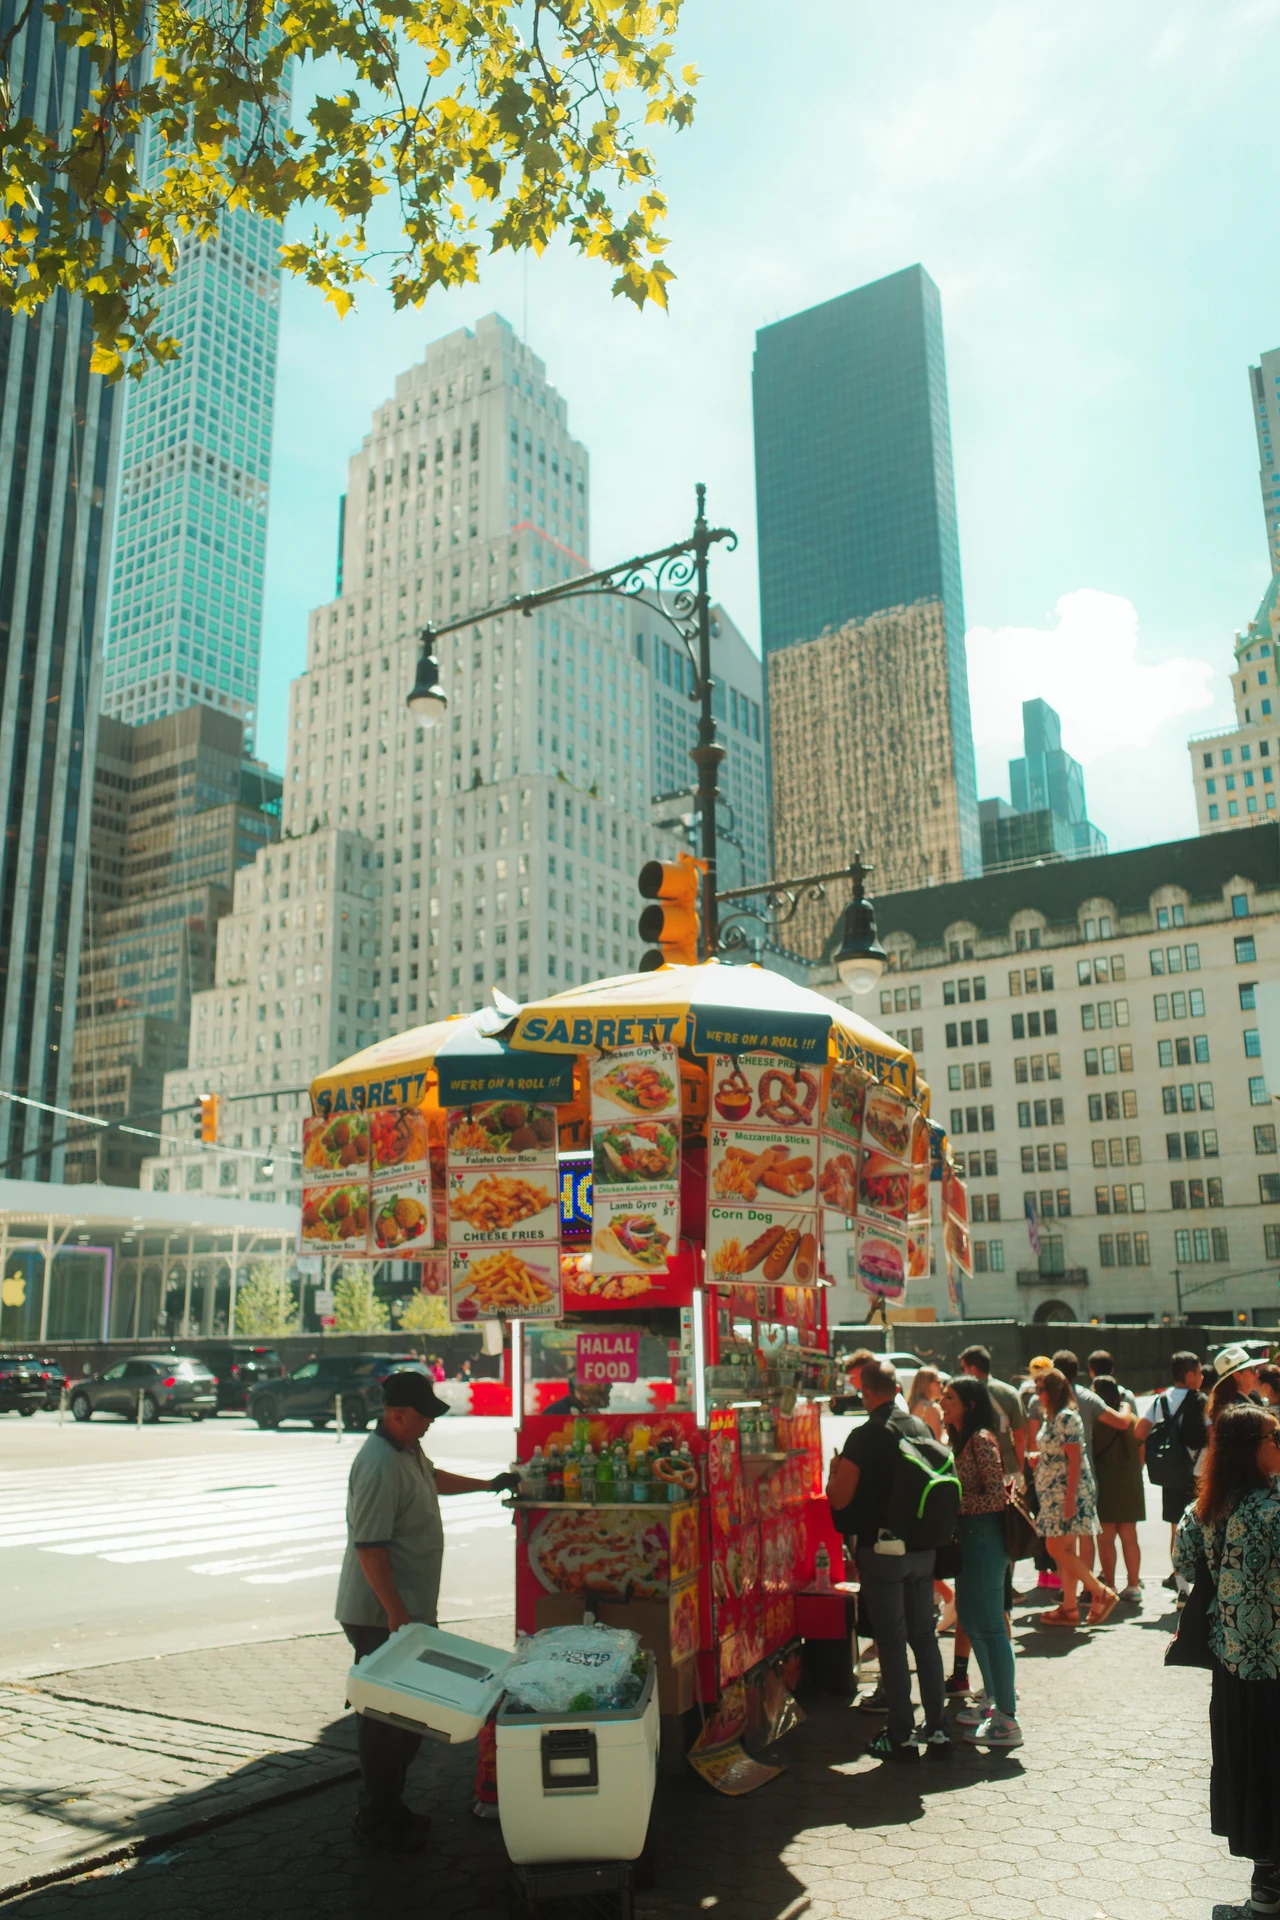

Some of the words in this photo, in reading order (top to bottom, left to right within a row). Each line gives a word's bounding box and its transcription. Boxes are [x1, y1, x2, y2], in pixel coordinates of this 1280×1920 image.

[520, 1014, 680, 1046] SABRETT
[705, 1028, 738, 1044] WE'RE
[741, 1033, 758, 1046] ON
[759, 1035, 769, 1047] A
[771, 1036, 799, 1049] ROLL
[801, 1038, 817, 1049] !!!
[636, 1047, 658, 1057] Gyro
[738, 1056, 776, 1067] CHEESE
[450, 1079, 484, 1091] WE'RE
[487, 1078, 505, 1089] ON
[507, 1078, 515, 1089] A
[517, 1077, 545, 1089] ROLL
[713, 1138, 728, 1146] NY
[735, 1132, 782, 1143] Mozzarella
[784, 1135, 811, 1145] Sticks
[465, 1156, 494, 1164] Falafel
[496, 1155, 516, 1163] Over
[518, 1155, 537, 1163] Rice
[597, 1186, 624, 1194] Chicken
[626, 1184, 647, 1192] Kebab
[659, 1183, 674, 1191] Pita
[609, 1202, 633, 1211] Lamb
[635, 1200, 657, 1211] Gyro
[711, 1208, 743, 1219] Corn
[747, 1210, 773, 1224] Dog
[464, 1232, 508, 1241] CHEESE
[512, 1230, 544, 1240] FRIES
[452, 1260, 469, 1269] NY
[580, 1337, 634, 1354] HALAL
[584, 1361, 630, 1379] FOOD
